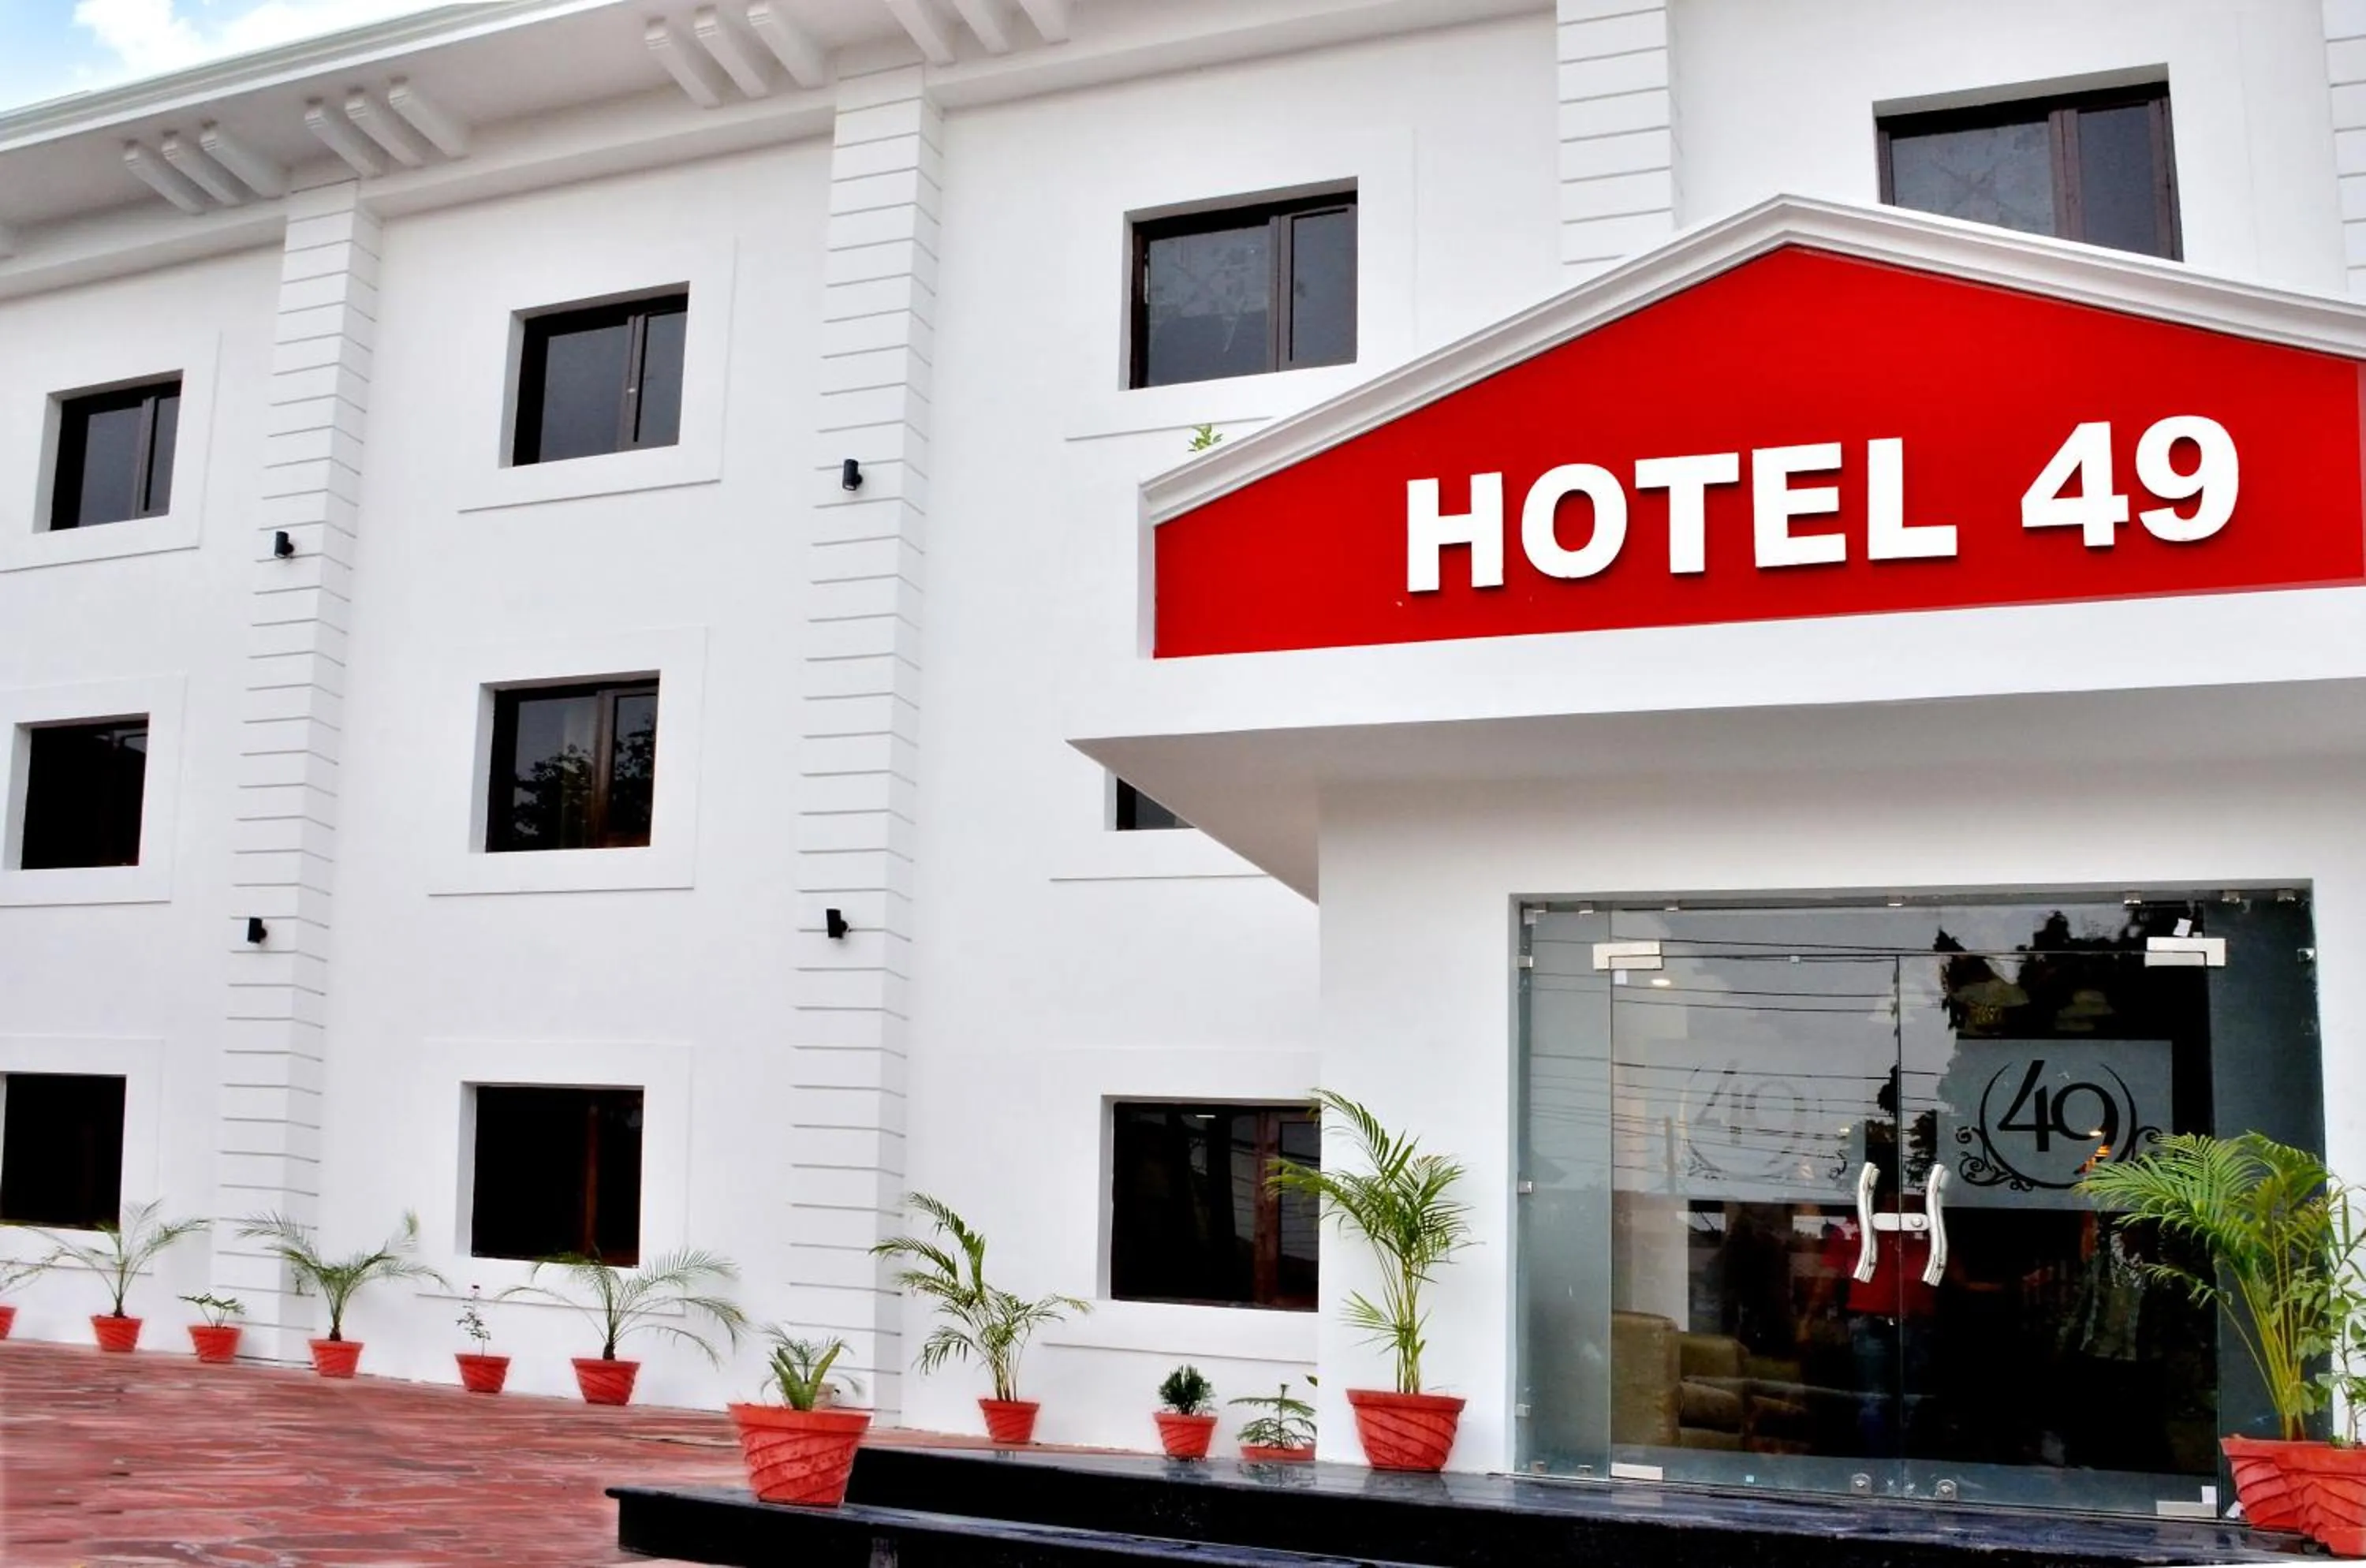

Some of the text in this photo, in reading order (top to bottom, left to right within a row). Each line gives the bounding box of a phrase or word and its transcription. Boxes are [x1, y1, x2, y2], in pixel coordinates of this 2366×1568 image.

[1407, 416, 2239, 592] HOTEL 49
[1696, 1060, 1806, 1168] 49
[1997, 1059, 2118, 1174] 49
